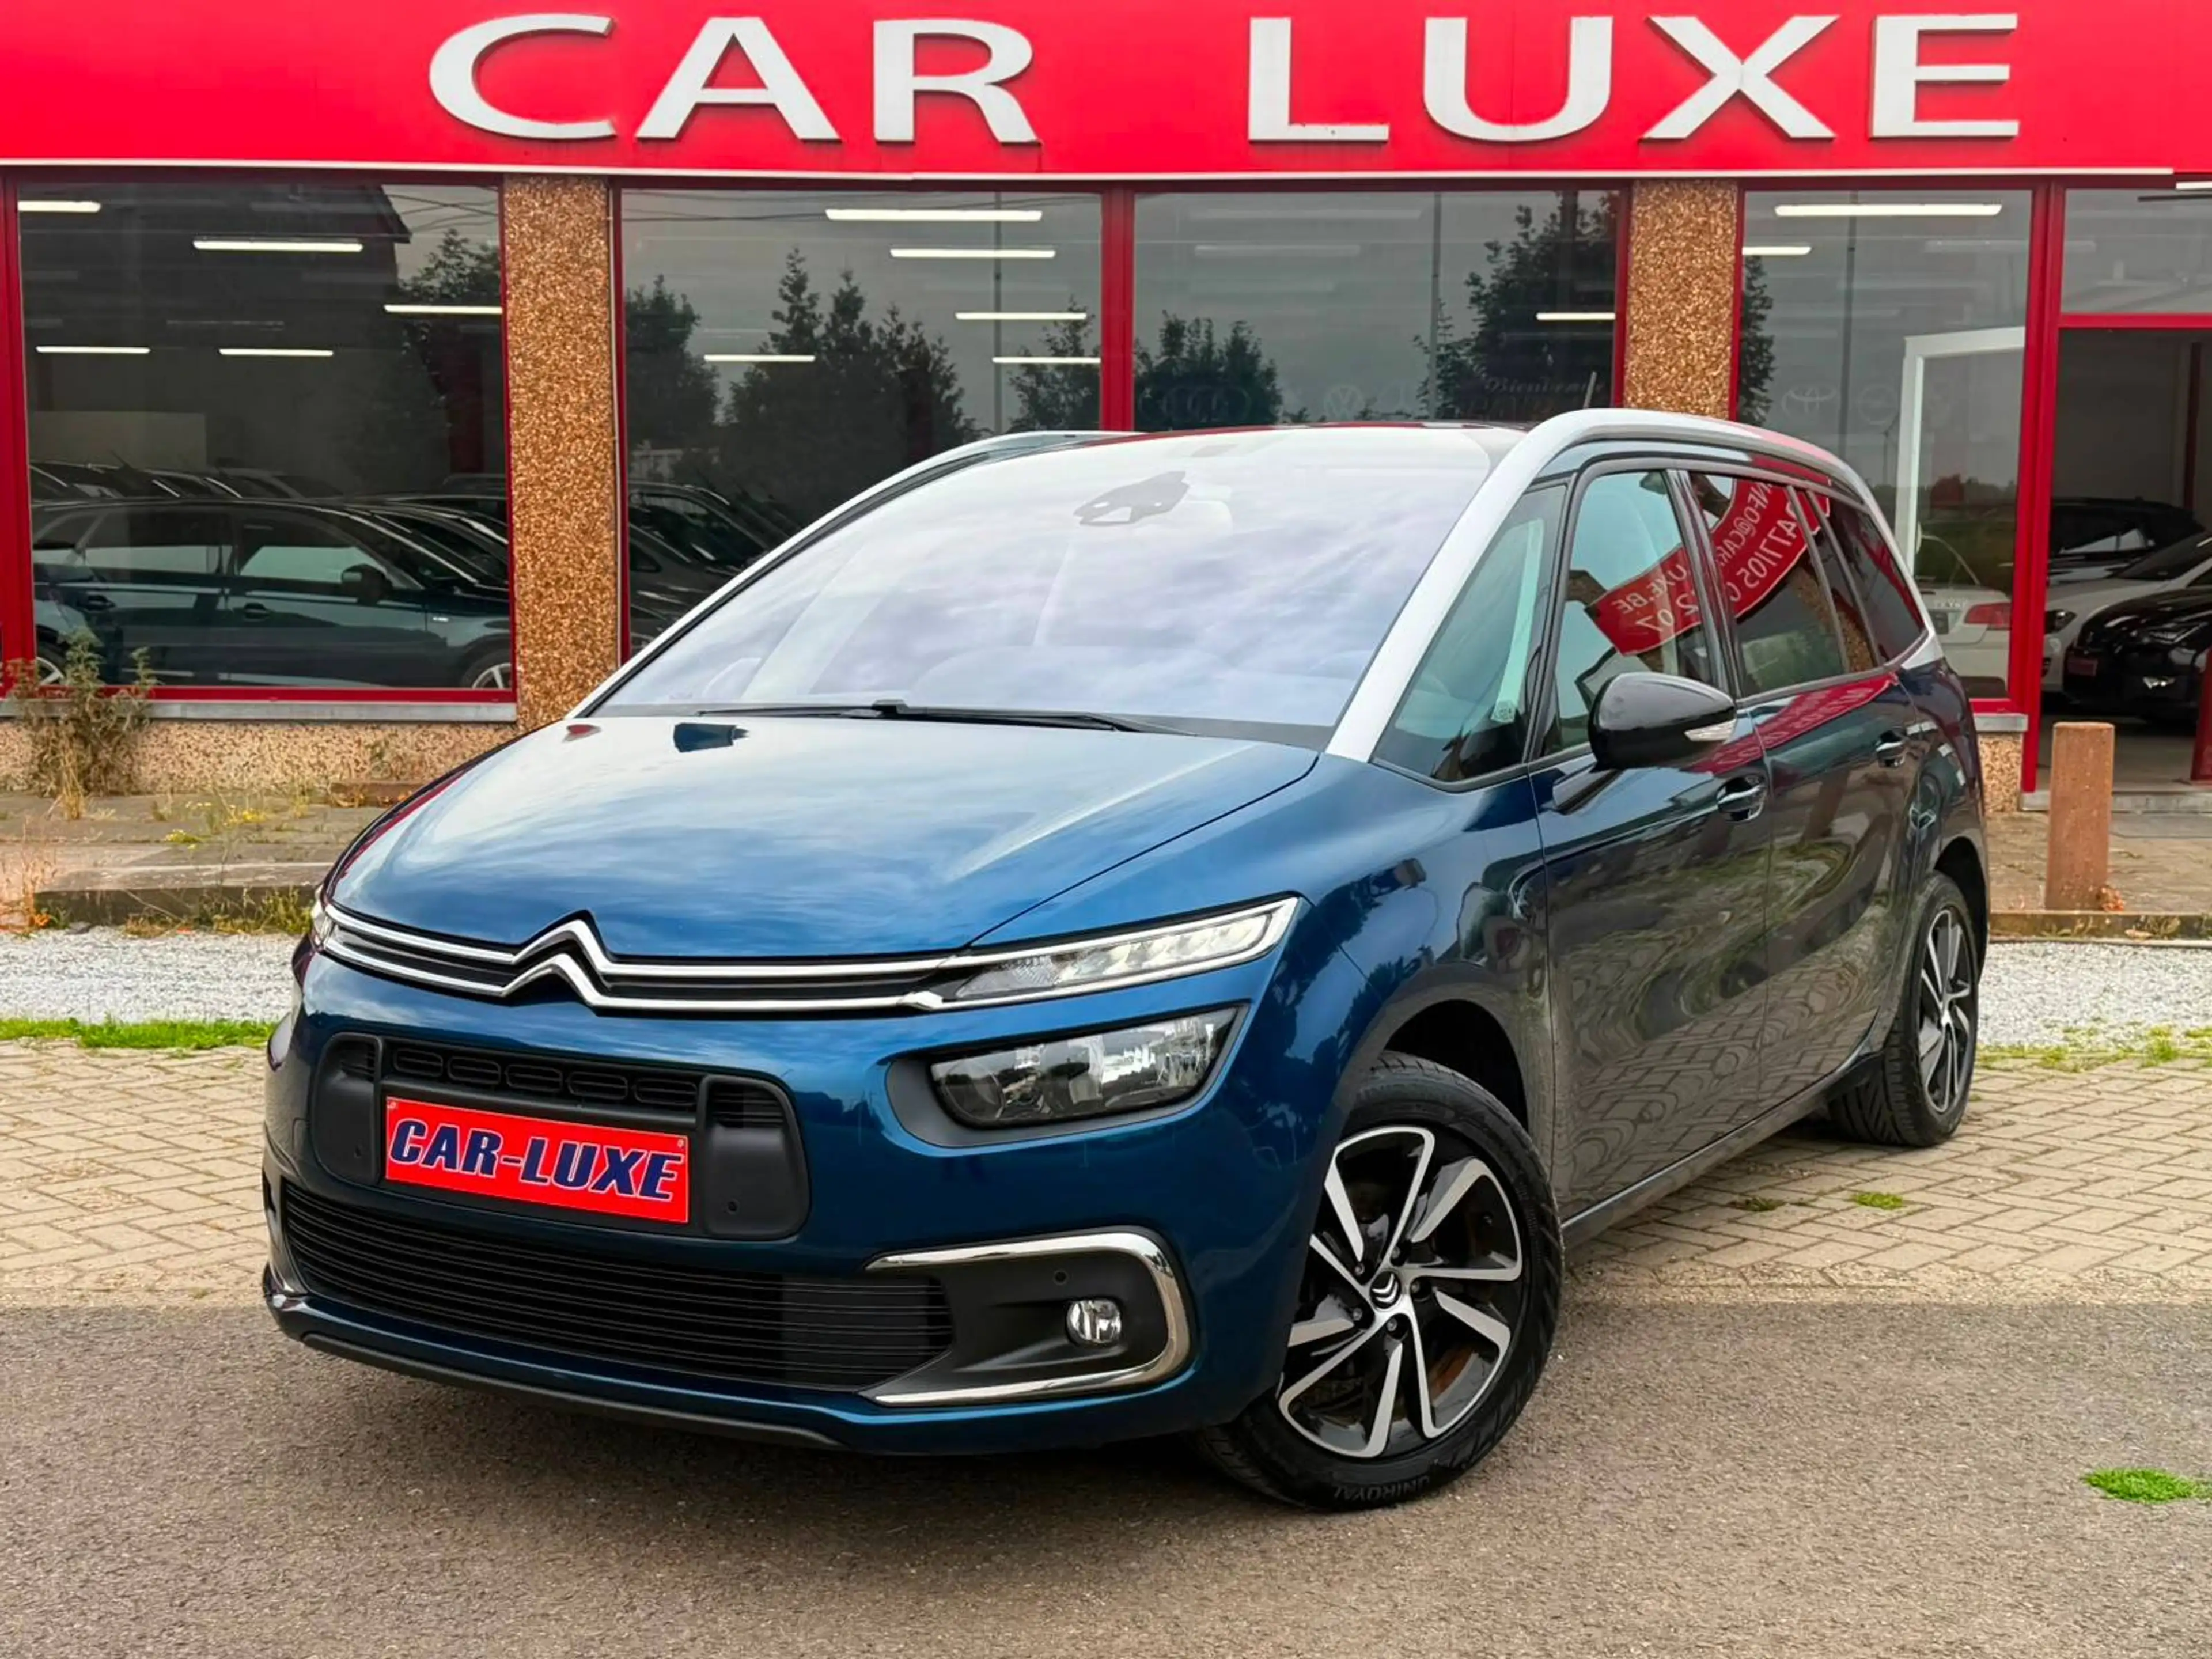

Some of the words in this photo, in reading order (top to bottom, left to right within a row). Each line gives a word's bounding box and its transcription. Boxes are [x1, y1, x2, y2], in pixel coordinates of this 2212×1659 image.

[429, 14, 1043, 145] CAR
[1248, 13, 2020, 142] LUXE
[388, 1118, 684, 1202] CAR-LUXE
[1334, 1475, 1430, 1502] UNIROYAL
